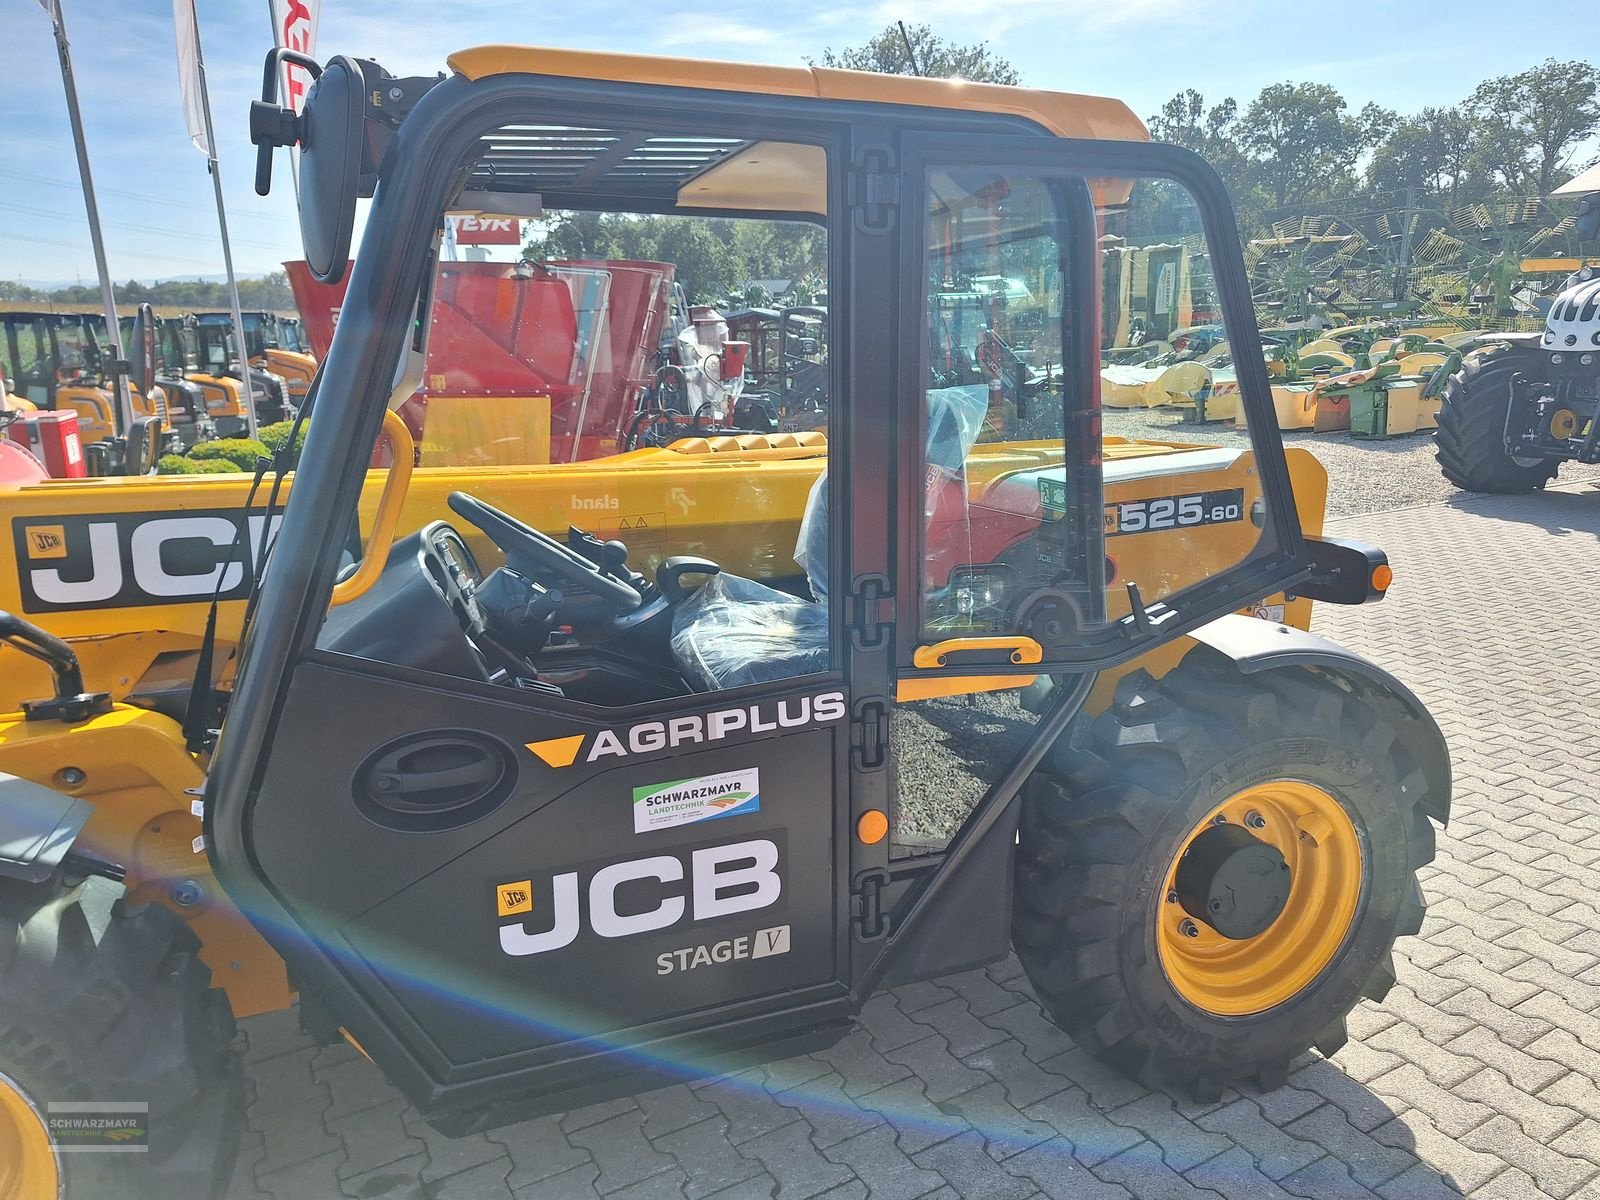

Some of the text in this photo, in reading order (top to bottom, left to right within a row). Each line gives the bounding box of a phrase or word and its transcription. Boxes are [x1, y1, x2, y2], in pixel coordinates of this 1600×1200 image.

[924, 467, 939, 491] JCB
[37, 532, 60, 550] JCB
[30, 515, 284, 604] JC
[1038, 554, 1052, 563] JCB
[646, 782, 742, 807] SCHWARZMAYR
[648, 800, 705, 815] LANDTECHNIK
[499, 839, 782, 956] JCB
[506, 891, 529, 906] JCB
[656, 936, 749, 976] STAGE
